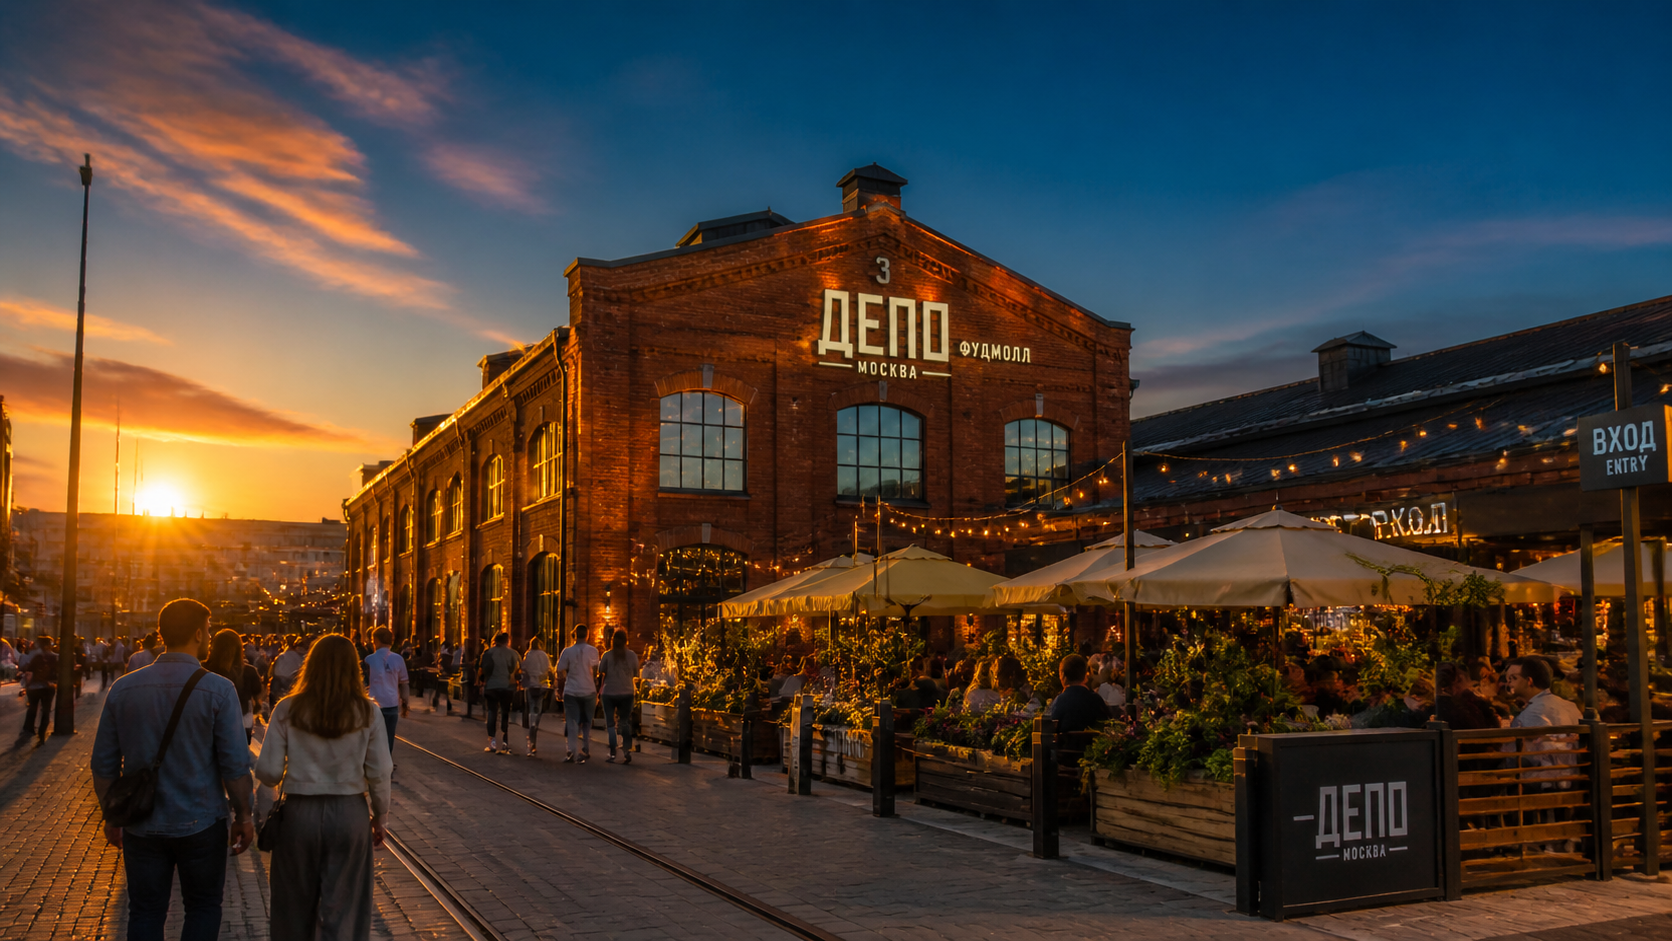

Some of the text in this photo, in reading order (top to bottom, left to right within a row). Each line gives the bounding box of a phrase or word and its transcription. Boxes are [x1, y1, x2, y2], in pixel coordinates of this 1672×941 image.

[875, 256, 891, 284] 3
[817, 288, 950, 363] ДЕПО
[959, 340, 1031, 363] ФУДМОЛЛ
[857, 361, 917, 379] МОСКВА
[1592, 420, 1657, 456] ВХОД
[1606, 455, 1648, 476] ENTRY
[1315, 781, 1408, 849] ДЕПО
[1343, 844, 1387, 861] МОСКВА
